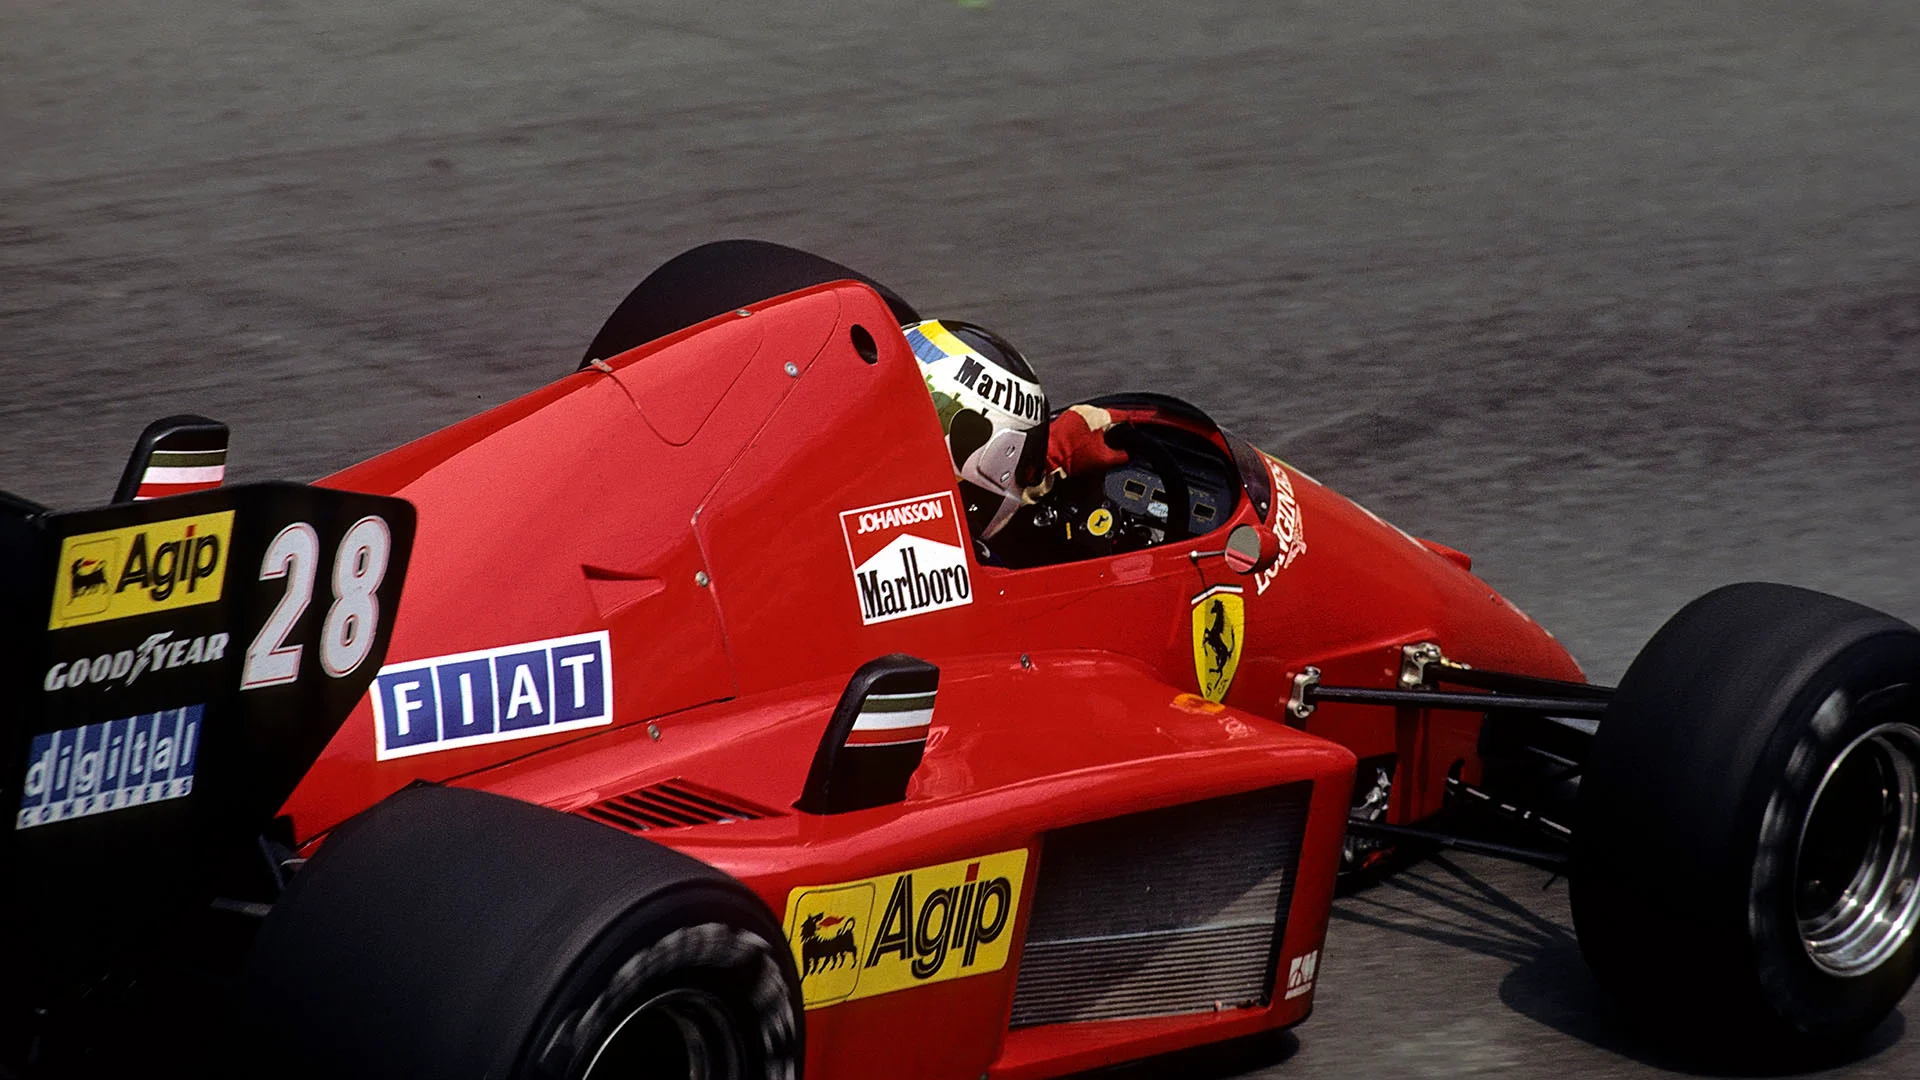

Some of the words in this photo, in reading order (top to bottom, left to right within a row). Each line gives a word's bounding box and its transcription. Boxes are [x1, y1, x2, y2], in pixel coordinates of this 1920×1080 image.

[953, 355, 1043, 422] Marlbor
[857, 499, 944, 535] JOHANSSON
[114, 524, 221, 602] Agip
[857, 546, 969, 620] Marlboro
[239, 515, 392, 691] 28
[393, 653, 596, 737] FIAT
[1205, 681, 1213, 698] S
[24, 721, 197, 798] digital
[21, 778, 194, 827] COMPUTERS
[863, 861, 1013, 980] Agip
